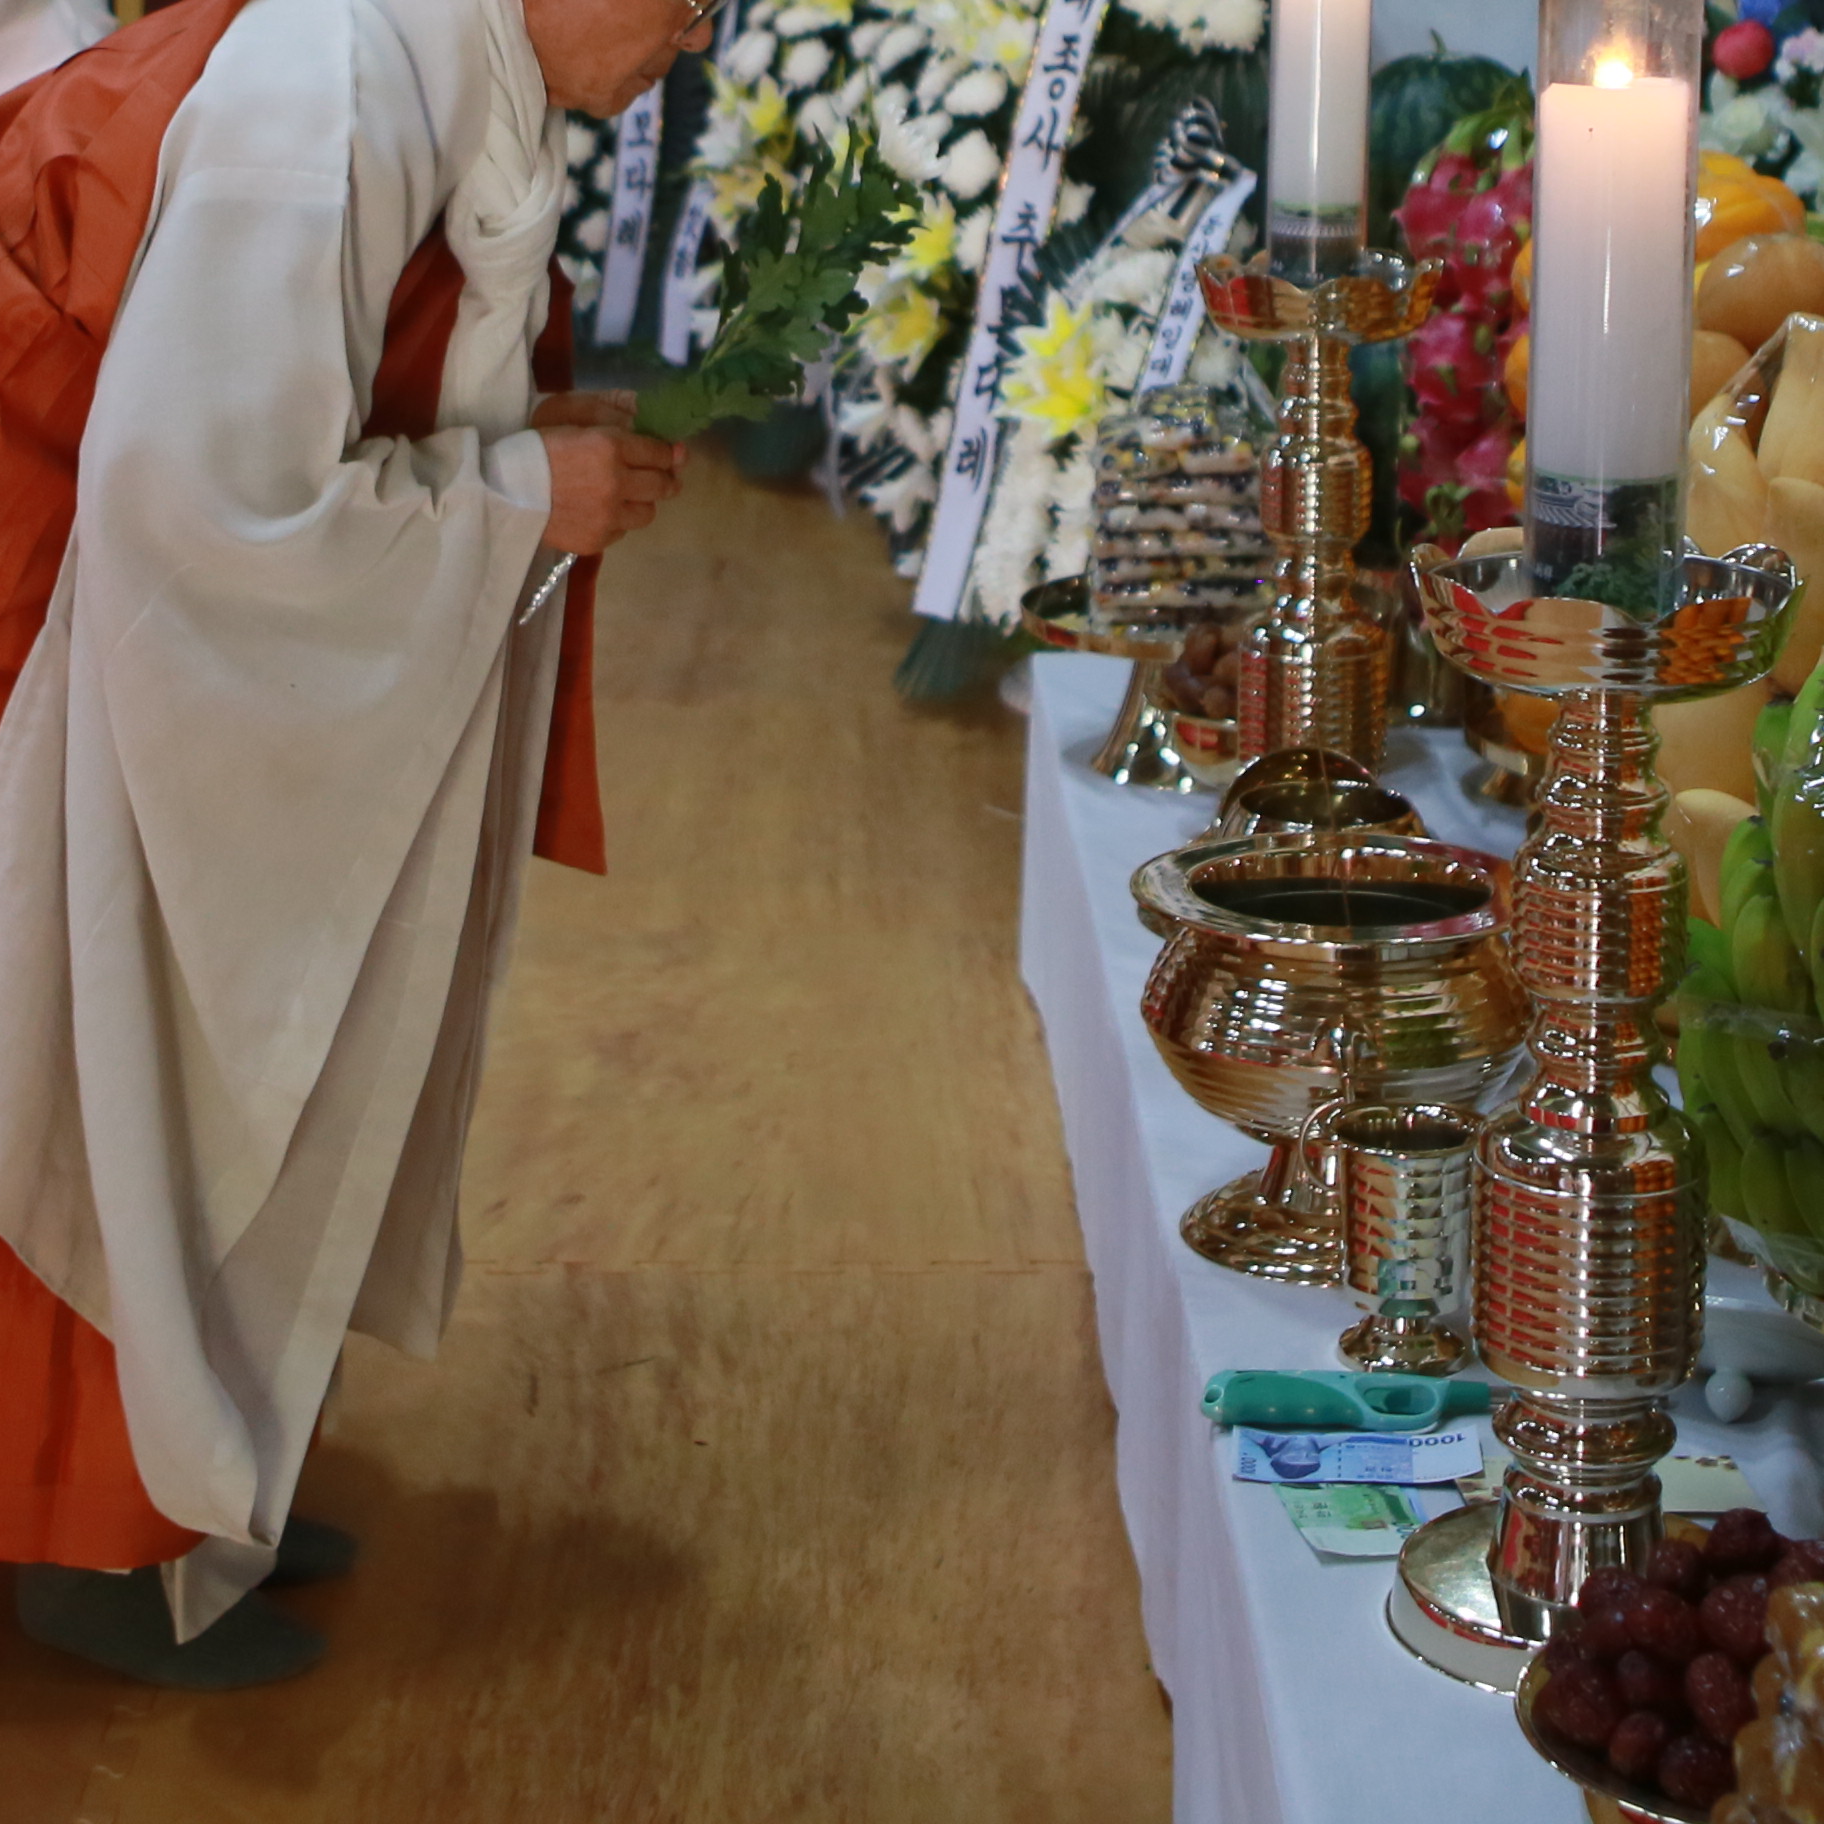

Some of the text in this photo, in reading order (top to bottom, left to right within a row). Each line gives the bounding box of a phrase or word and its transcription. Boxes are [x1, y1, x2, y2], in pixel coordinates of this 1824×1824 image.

[616, 84, 654, 250] 모다례
[956, 201, 1038, 496] 추다례
[1408, 1433, 1466, 1447] 1000
